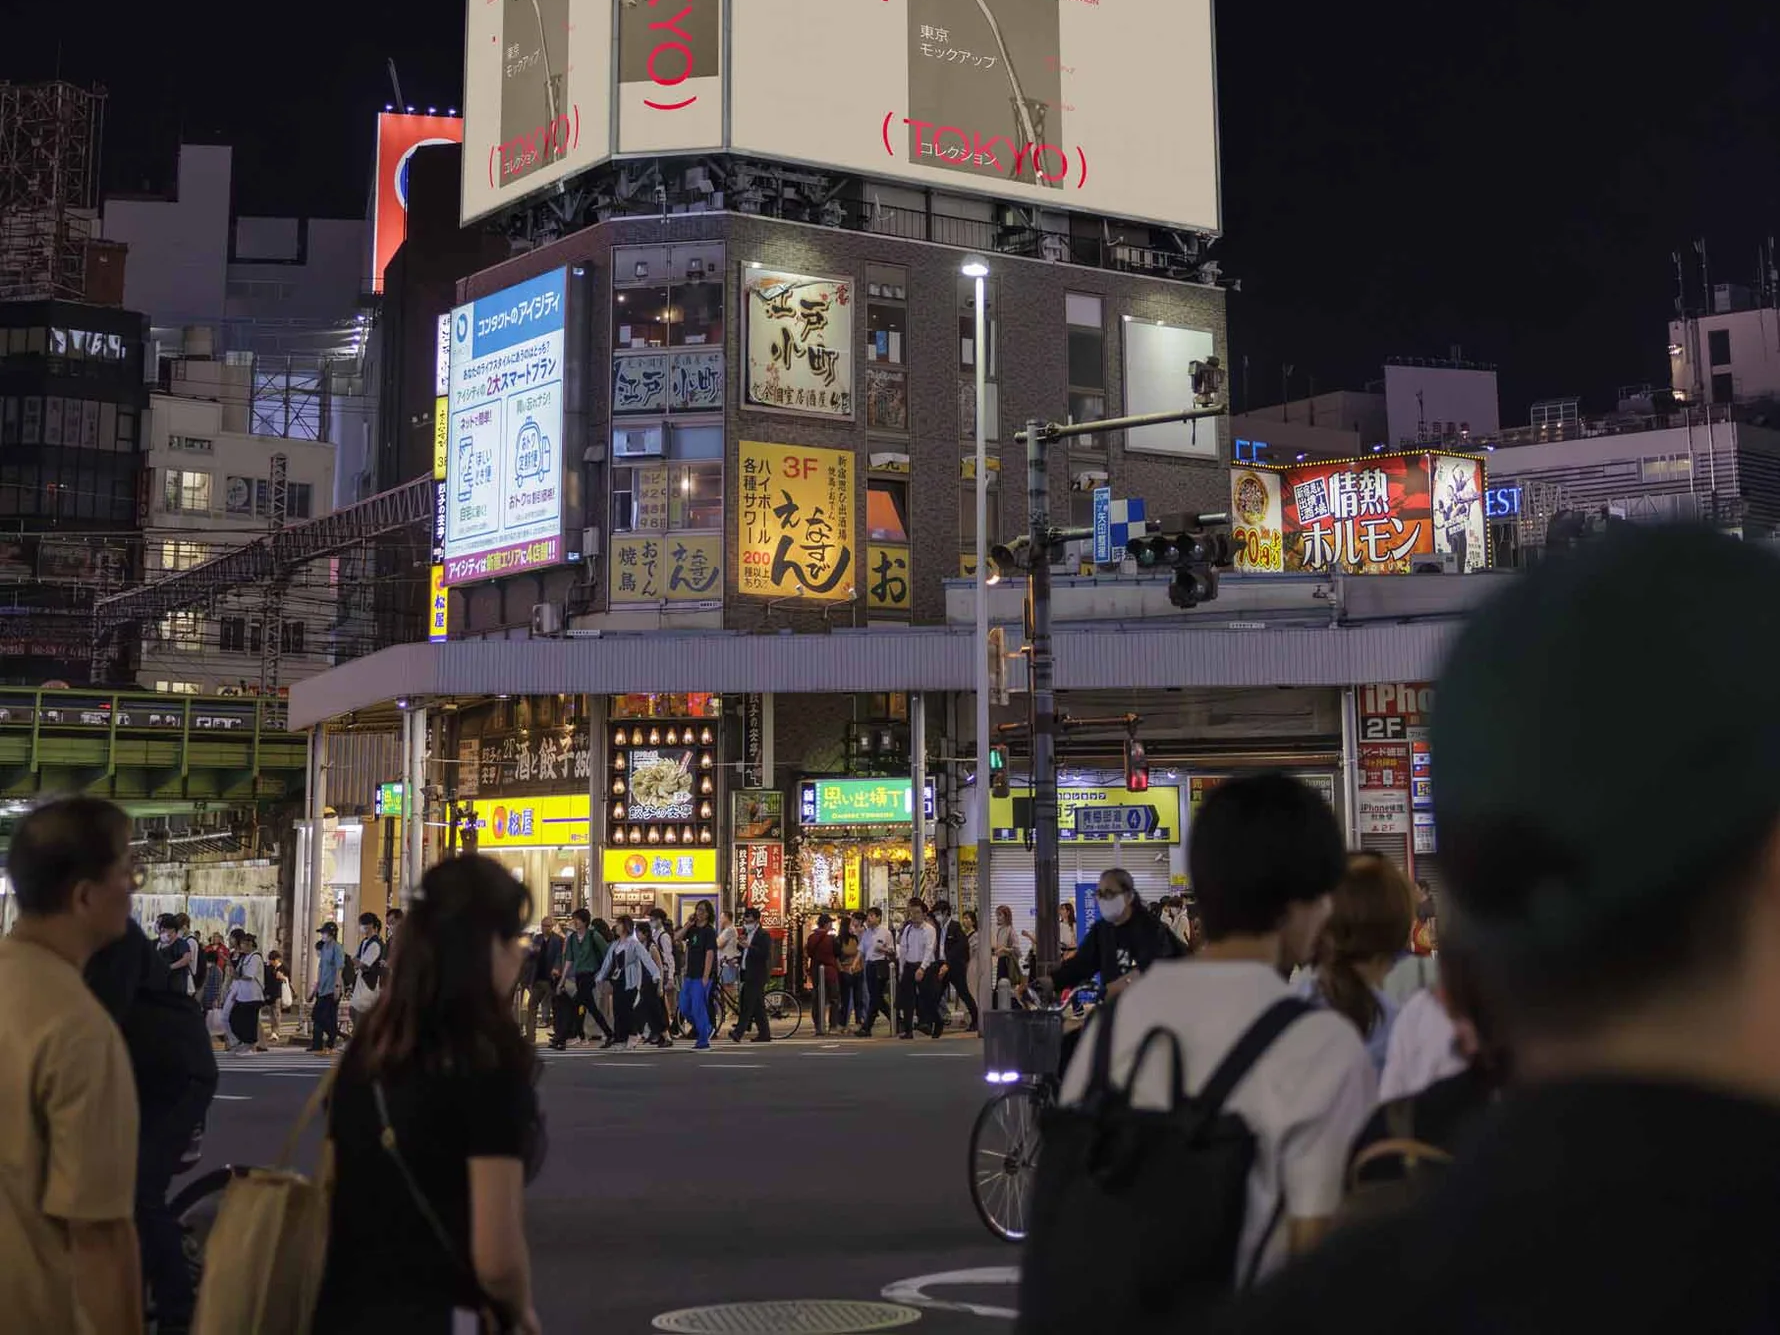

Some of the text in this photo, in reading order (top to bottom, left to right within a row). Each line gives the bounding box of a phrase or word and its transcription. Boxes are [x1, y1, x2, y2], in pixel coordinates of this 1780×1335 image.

[920, 25, 949, 42] 東京
[920, 43, 997, 69] モックアップ
[478, 291, 561, 337] コンタクトのアイシティ
[783, 456, 818, 479] 3F
[743, 458, 757, 544] 各種サワー
[758, 458, 771, 544] ハイボール
[1329, 468, 1390, 518] 情熱
[743, 550, 769, 565] 200
[1302, 516, 1421, 567] ホルモン
[618, 547, 637, 592] 焼鳥
[642, 540, 658, 597] おでん
[871, 550, 906, 603] お
[434, 595, 446, 628] 松屋
[1366, 717, 1402, 738] 2F
[824, 786, 905, 810] 思い出横丁
[508, 809, 534, 836] 松屋
[651, 856, 693, 877] 松屋
